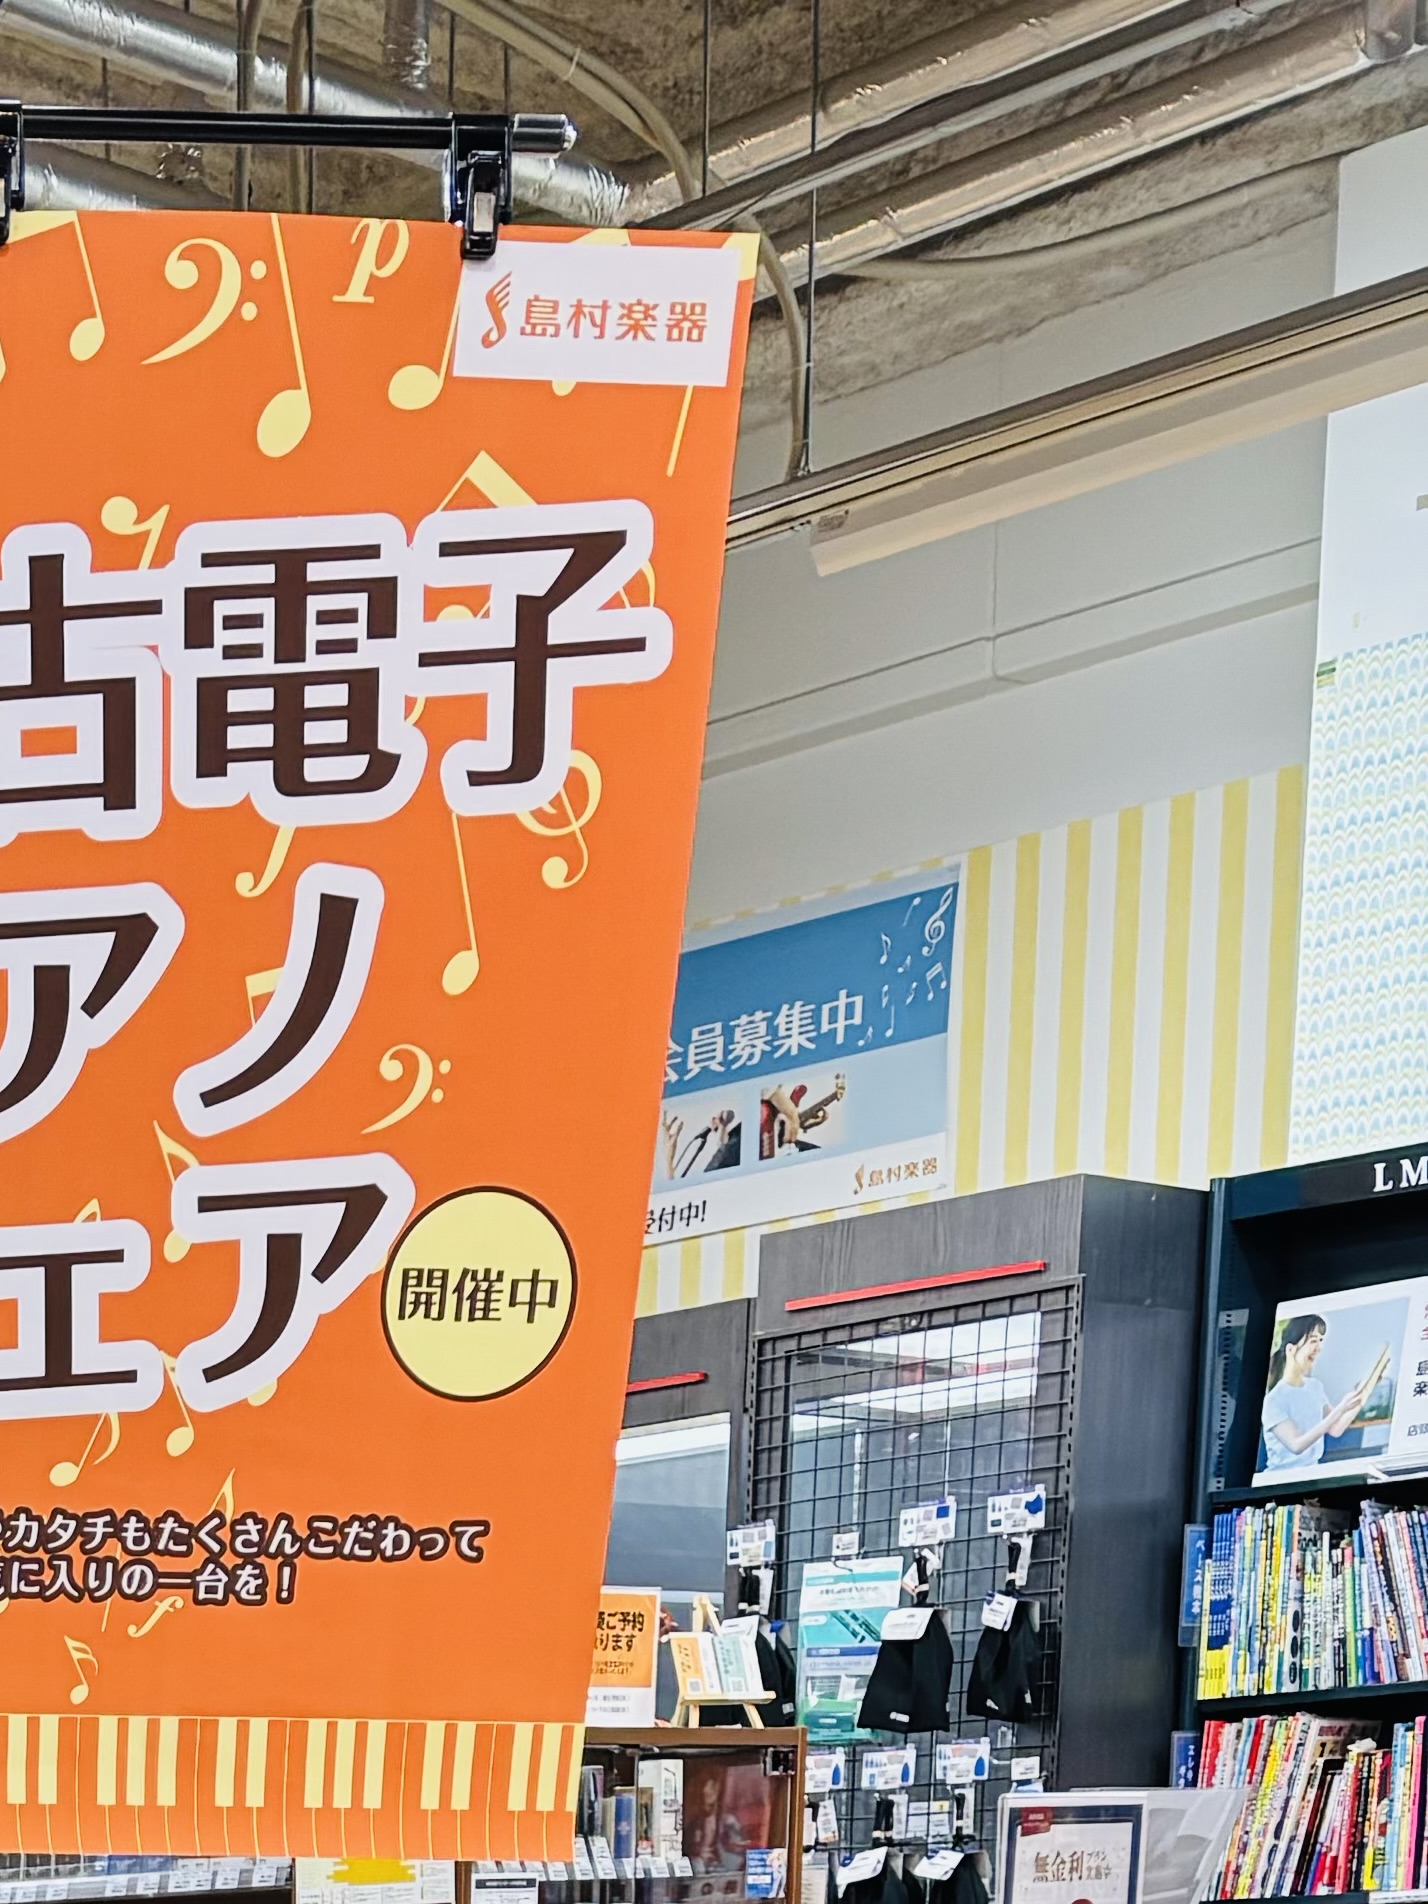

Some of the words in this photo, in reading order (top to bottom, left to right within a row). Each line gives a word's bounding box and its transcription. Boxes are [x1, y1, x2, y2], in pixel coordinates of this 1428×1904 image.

[519, 294, 709, 346] 島村楽器
[867, 1156, 938, 1189] 島村楽器
[395, 1266, 561, 1326] 開催中
